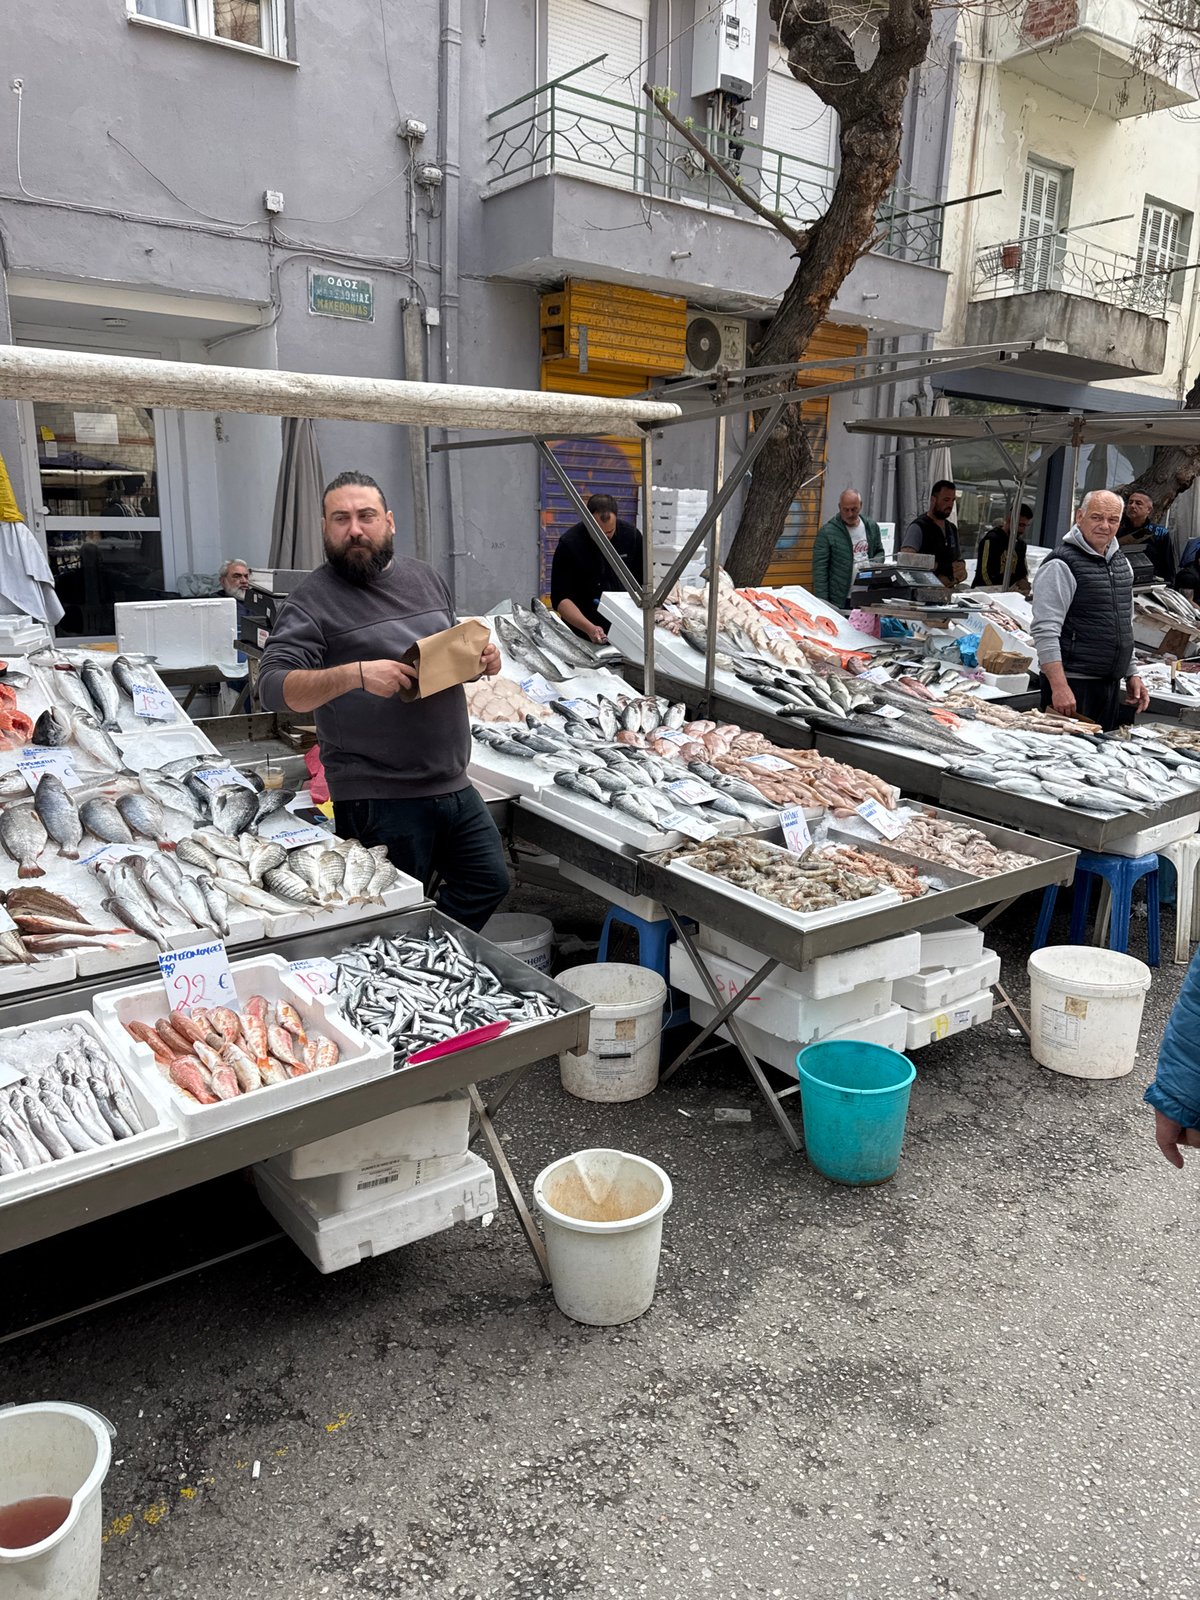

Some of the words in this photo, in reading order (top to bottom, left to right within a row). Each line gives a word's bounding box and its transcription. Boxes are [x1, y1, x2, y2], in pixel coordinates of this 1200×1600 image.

[327, 277, 358, 290] ΟΔΟΣ
[316, 299, 368, 315] MAKEDONIAS
[173, 974, 212, 1012] 22
